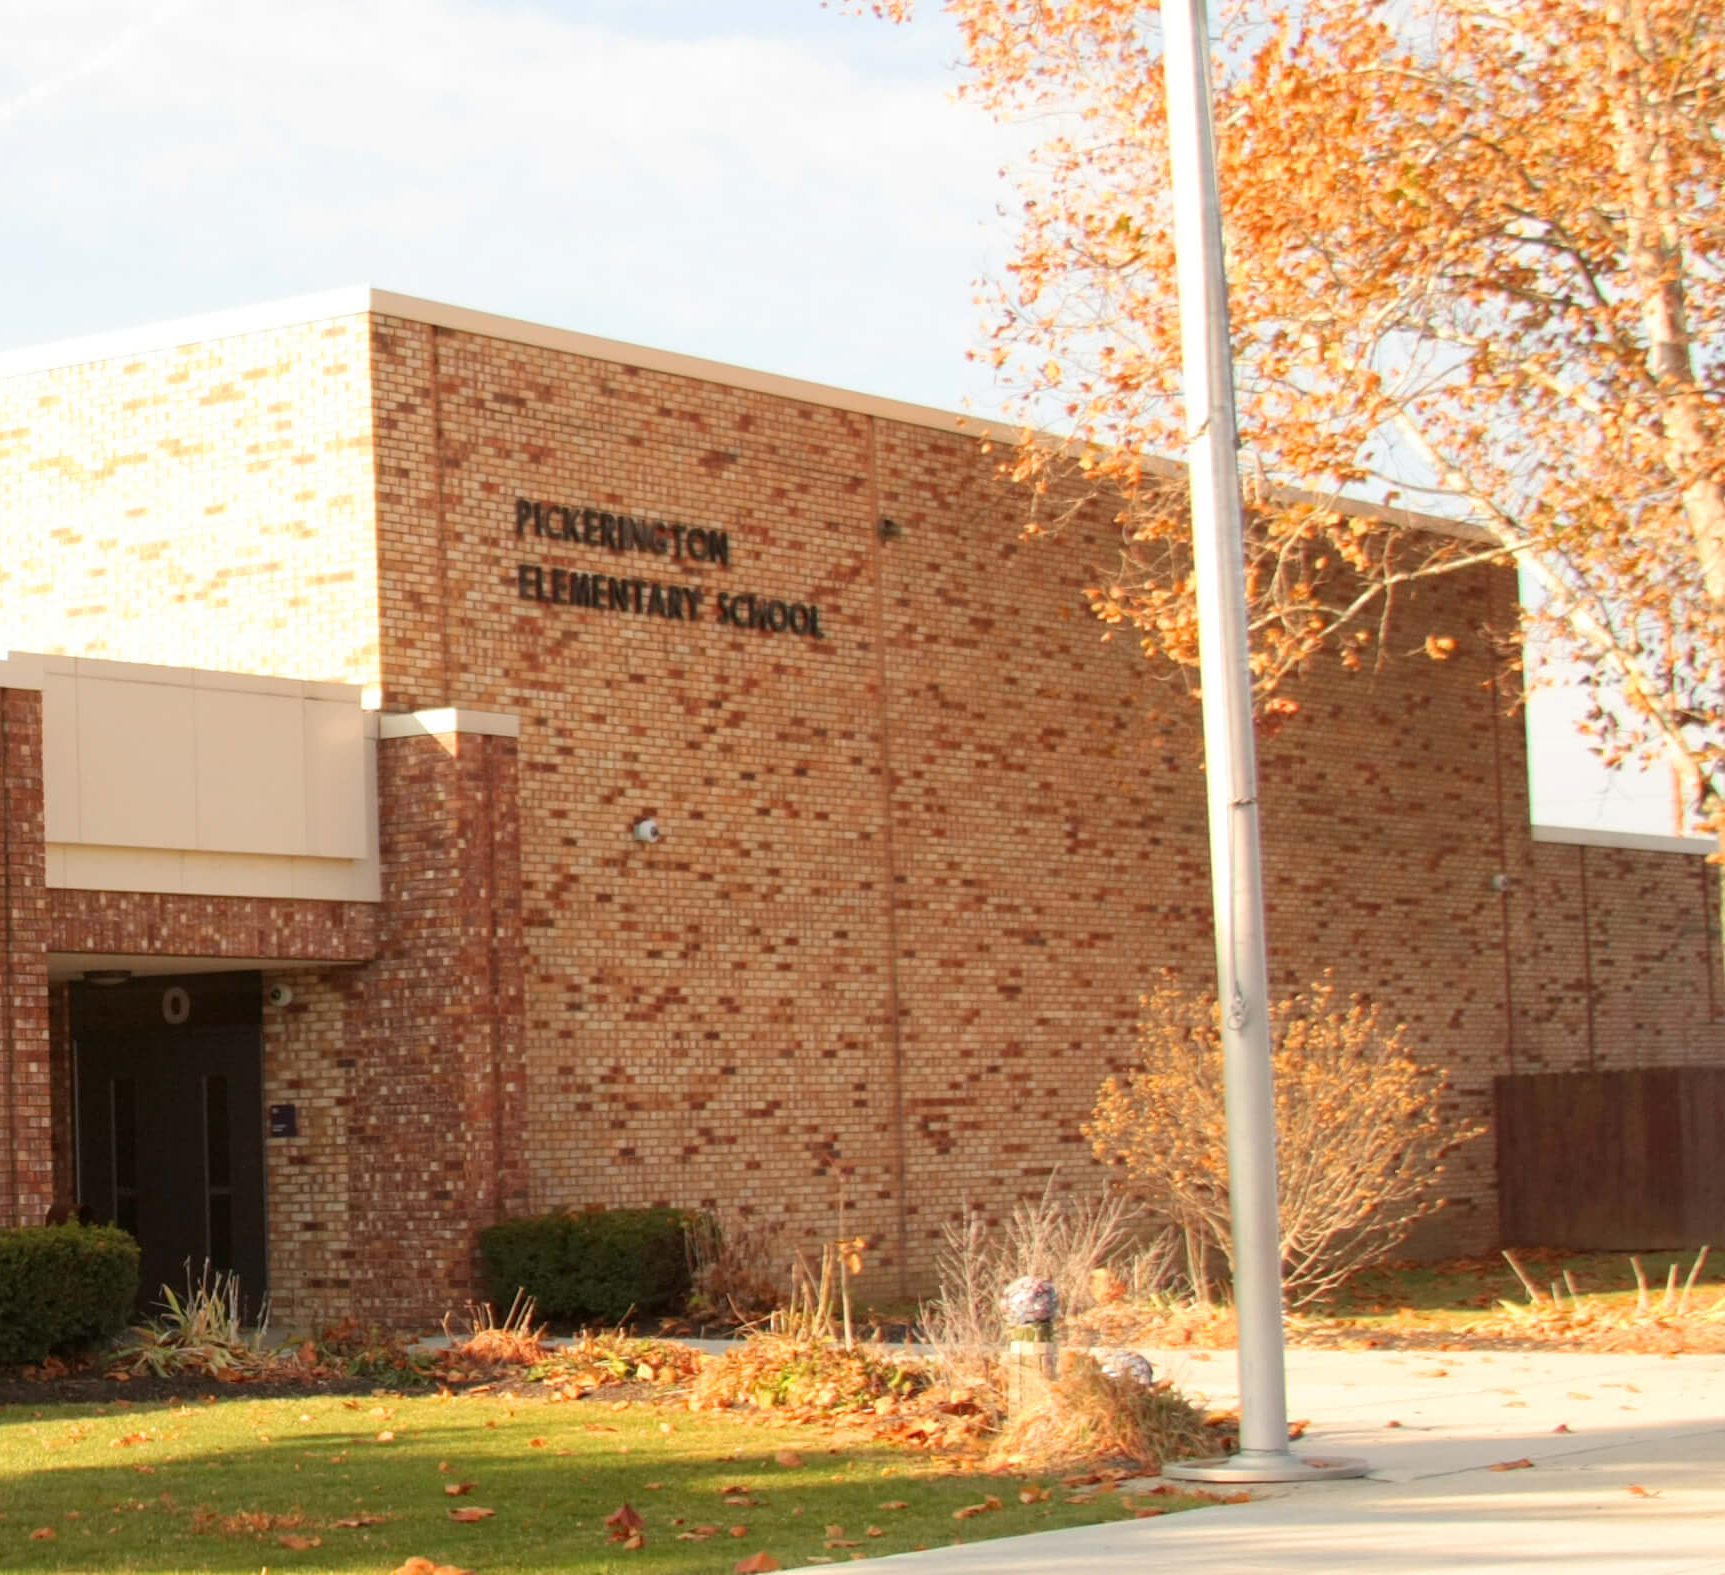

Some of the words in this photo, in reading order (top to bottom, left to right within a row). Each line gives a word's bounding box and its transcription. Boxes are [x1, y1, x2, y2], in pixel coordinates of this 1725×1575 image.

[516, 498, 730, 566] PICKERINGTON
[518, 564, 702, 621] ELEMENTARY
[717, 592, 824, 638] SCHOOL
